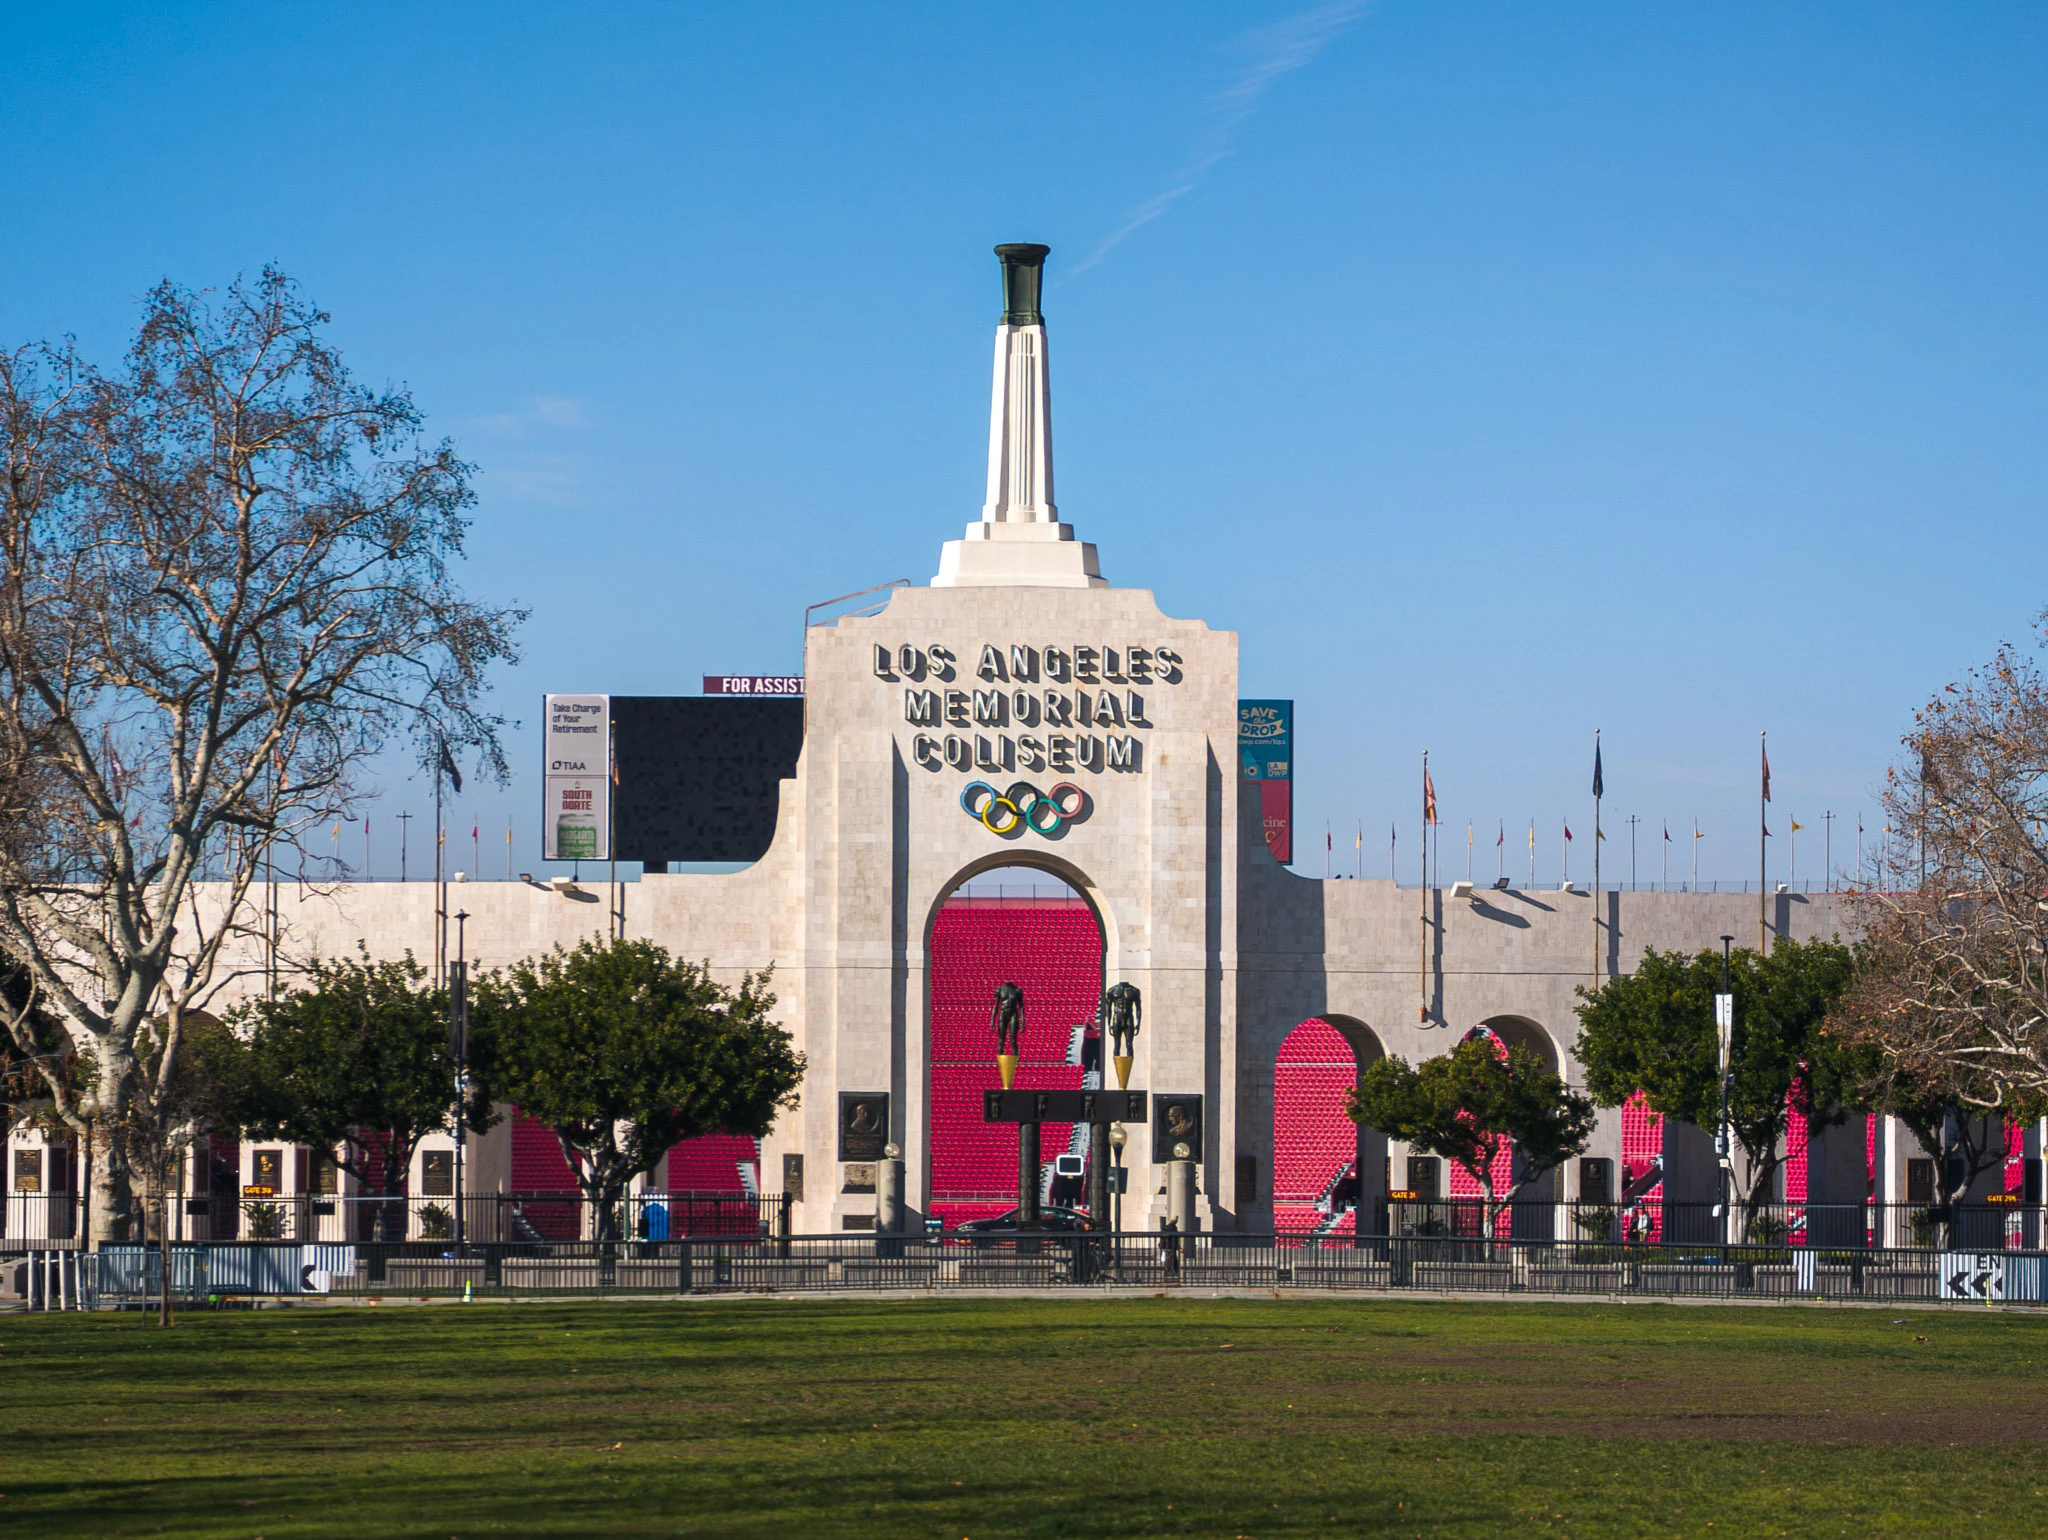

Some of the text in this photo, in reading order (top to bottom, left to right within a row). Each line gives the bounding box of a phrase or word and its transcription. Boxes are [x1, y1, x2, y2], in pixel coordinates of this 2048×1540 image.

[873, 643, 1175, 679] LOS ANGELES
[722, 677, 751, 693] FOR
[552, 703, 602, 715] Take Charge
[904, 687, 1144, 722] MEMORIAL
[552, 714, 582, 723] of Your
[1240, 706, 1279, 720] SAVE
[552, 724, 598, 734] Retirement
[1241, 723, 1278, 737] DROP
[912, 732, 1134, 767] COLISEUM
[563, 761, 586, 770] TIAA
[562, 789, 593, 800] SOUTH
[244, 1186, 261, 1194] GATE
[1391, 1191, 1408, 1199] GATE
[1987, 1194, 2003, 1202] GATE
